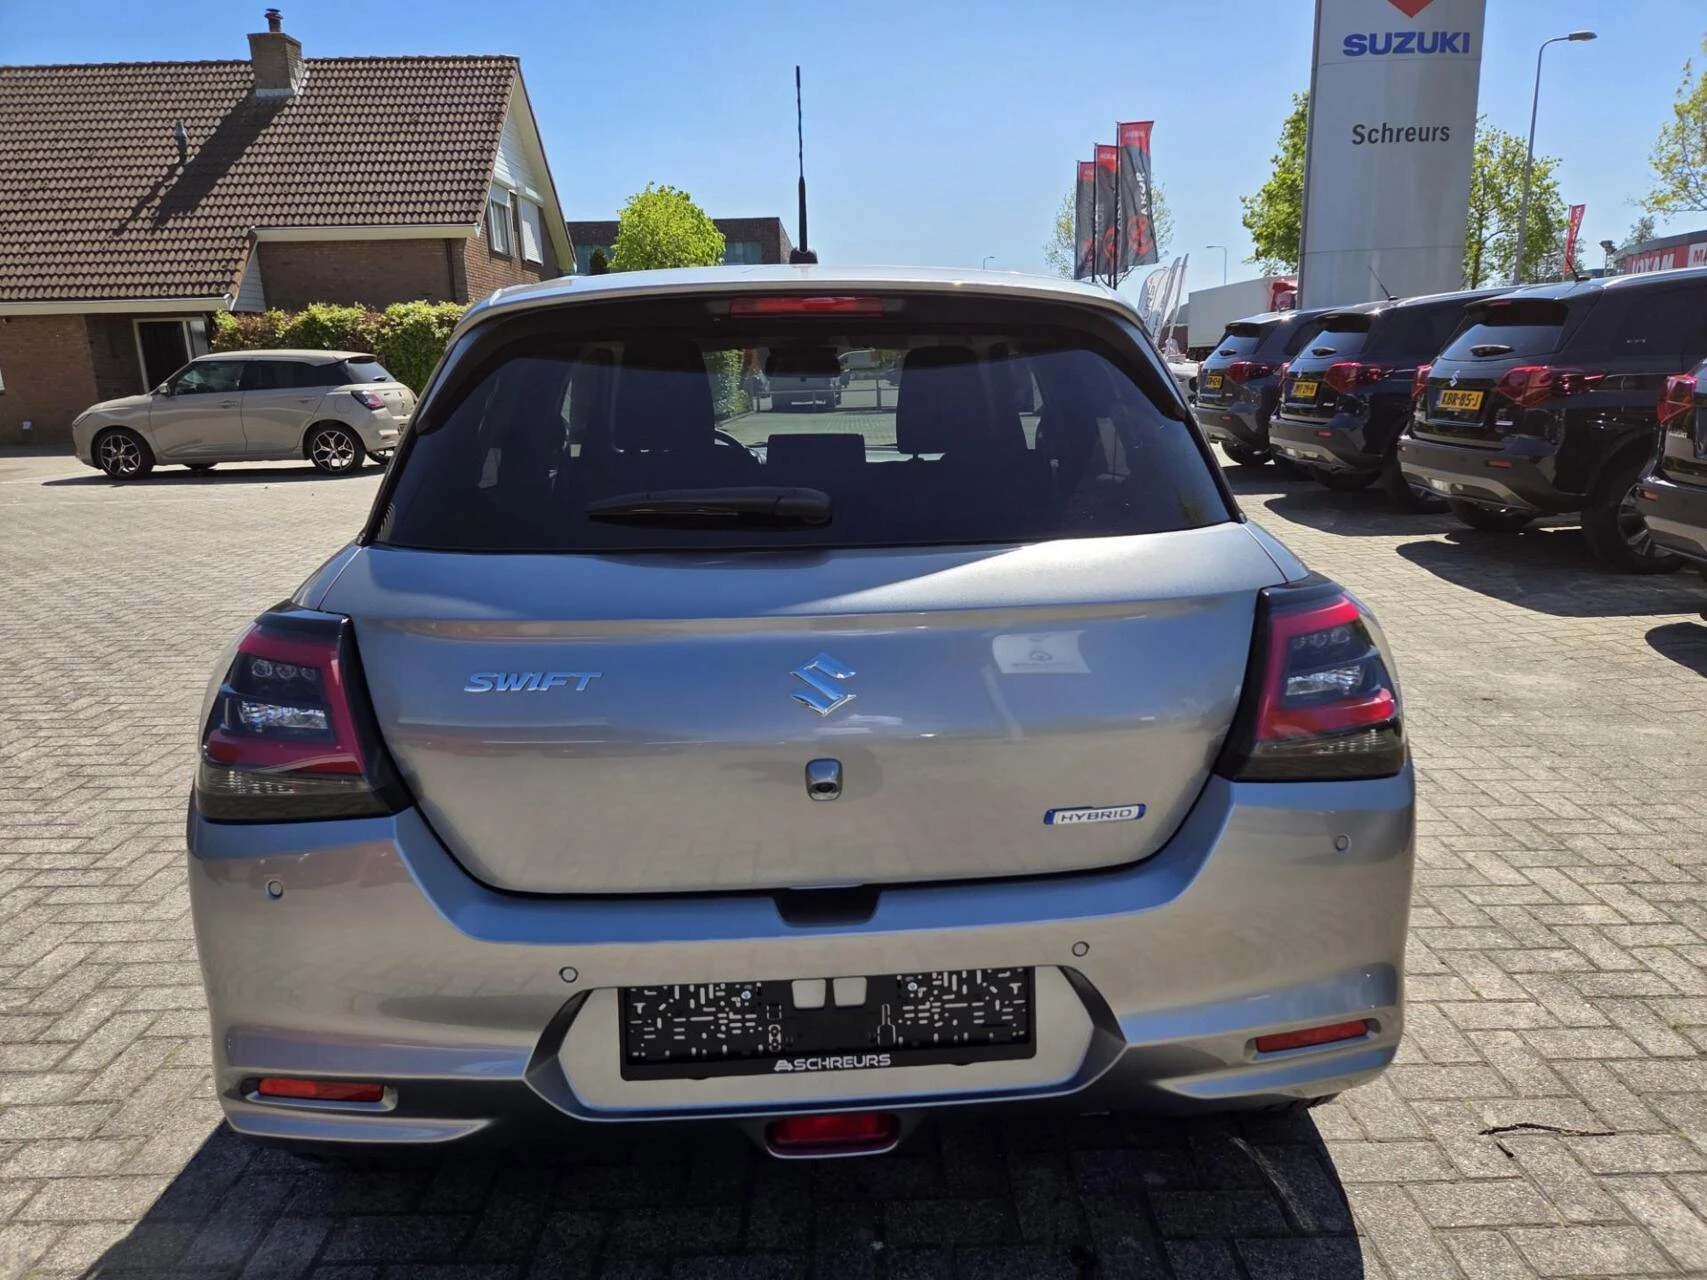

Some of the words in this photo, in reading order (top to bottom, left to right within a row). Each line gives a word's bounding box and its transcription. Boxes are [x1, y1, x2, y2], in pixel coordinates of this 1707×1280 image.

[1342, 30, 1470, 57] SUZUKI
[1351, 121, 1451, 146] Schreurs
[464, 671, 602, 693] SWIFT
[1060, 809, 1133, 823] HYBRID
[793, 1053, 892, 1072] SCHREURS
